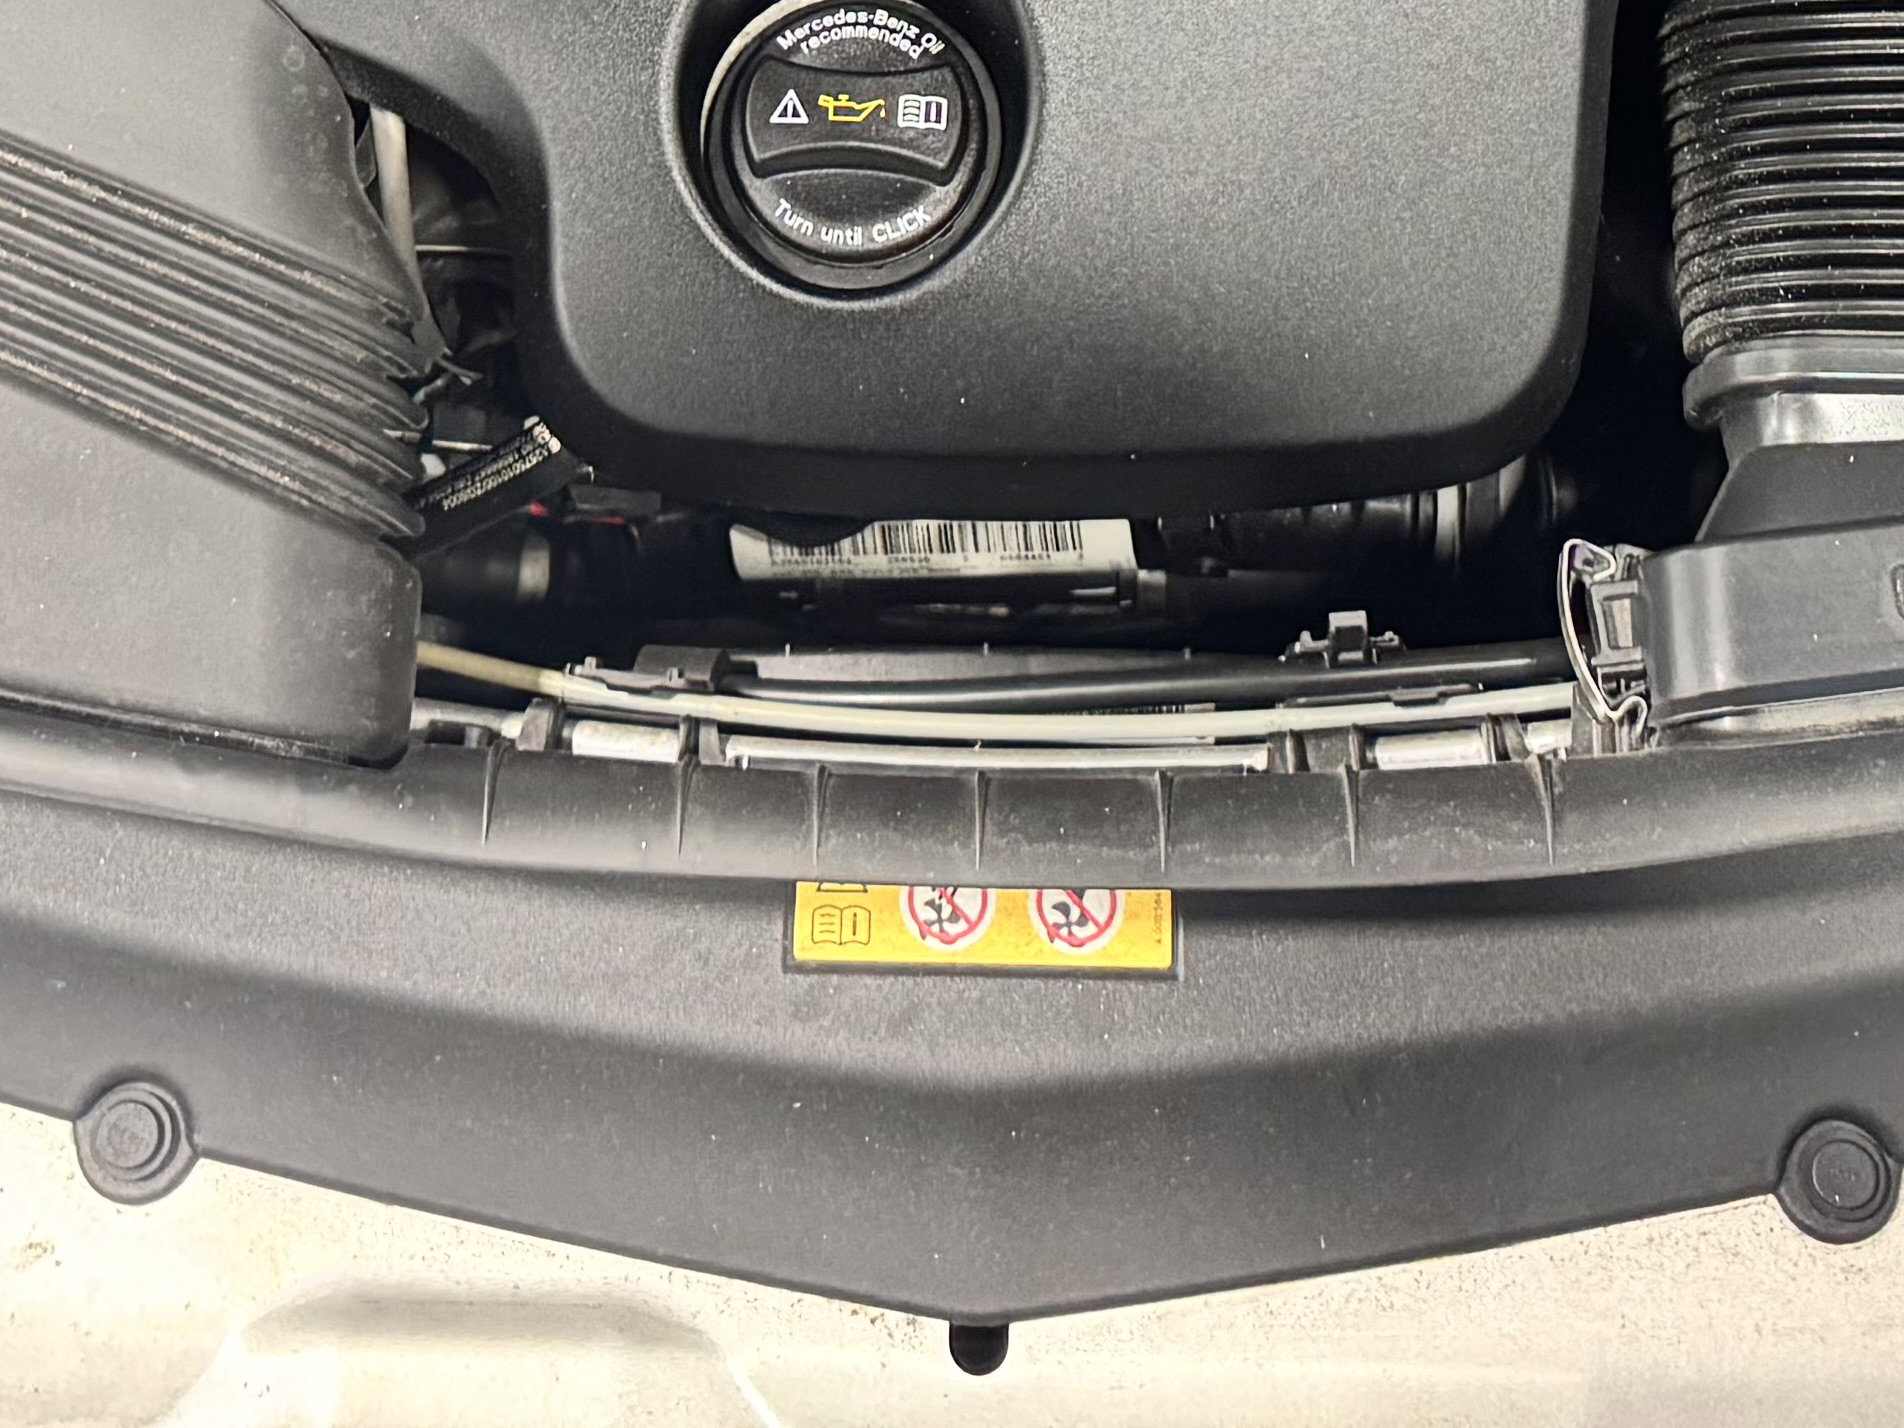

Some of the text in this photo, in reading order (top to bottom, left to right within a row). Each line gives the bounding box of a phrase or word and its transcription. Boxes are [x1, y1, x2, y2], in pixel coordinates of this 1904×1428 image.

[775, 8, 945, 56] Mercedes-Benz Oil
[800, 25, 925, 61] recommended
[773, 198, 933, 247] Turn until CLICK
